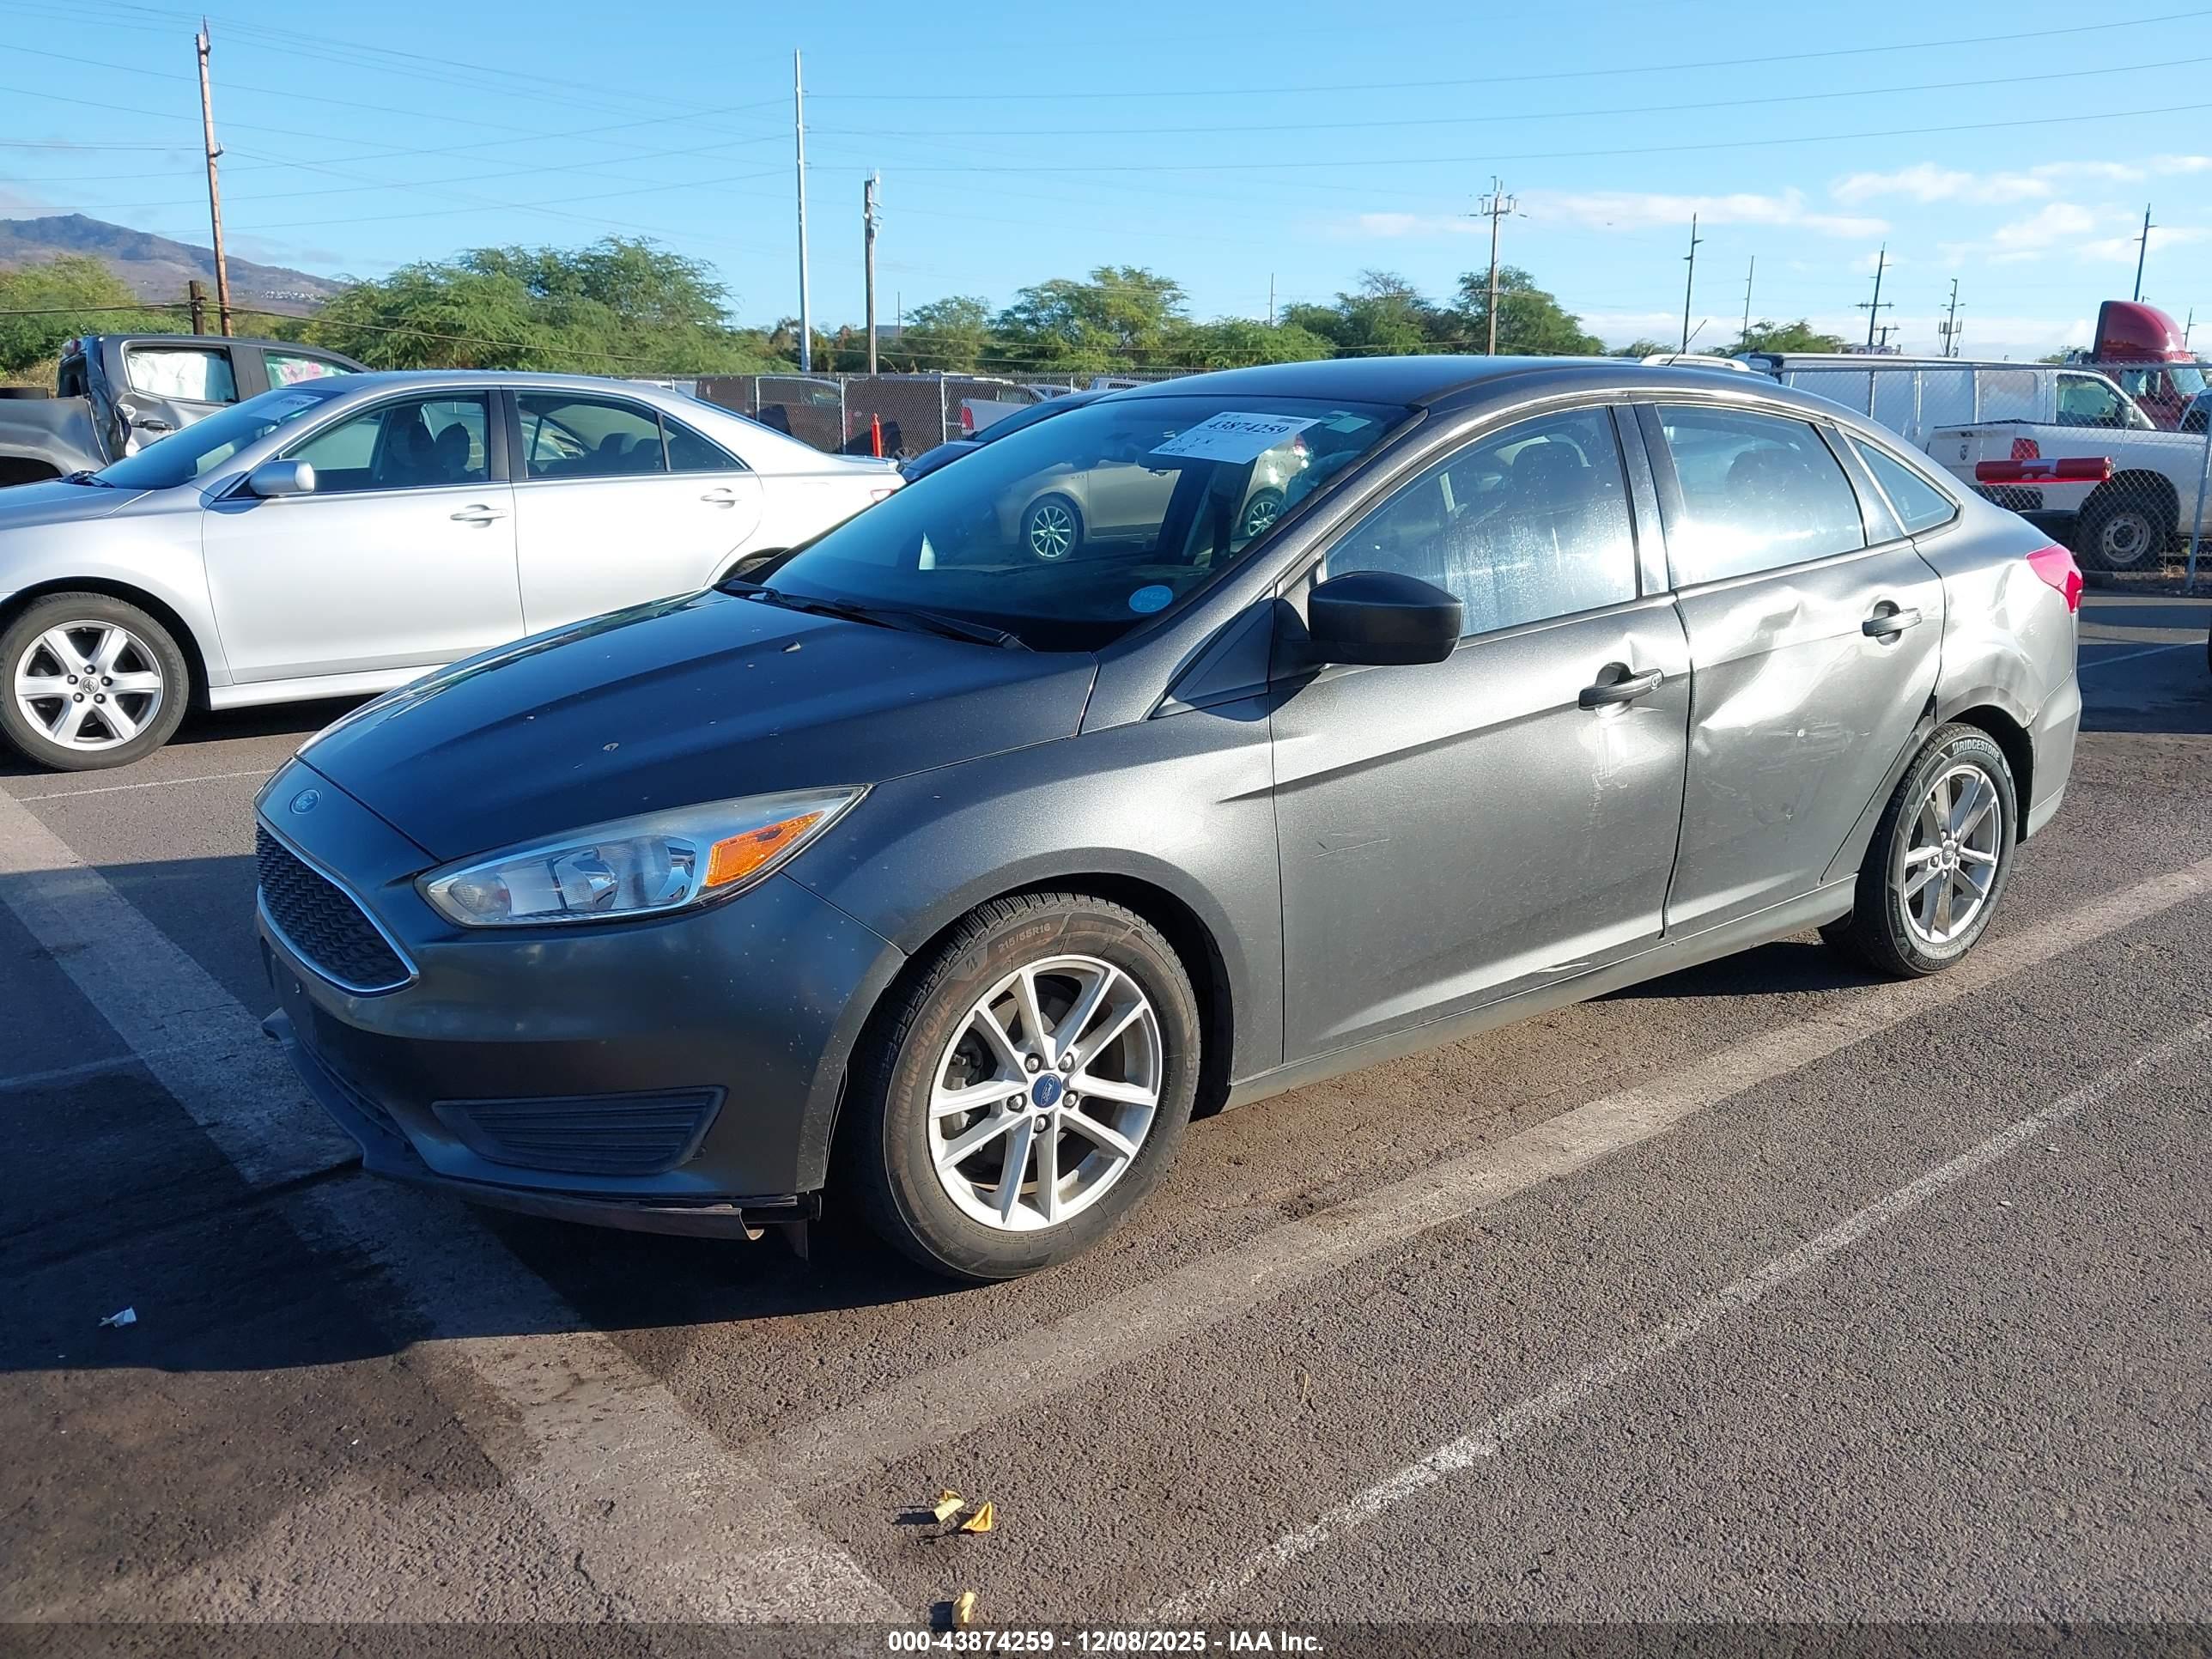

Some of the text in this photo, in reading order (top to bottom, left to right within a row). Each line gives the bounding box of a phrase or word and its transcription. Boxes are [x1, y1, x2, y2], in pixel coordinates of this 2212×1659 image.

[1207, 420, 1290, 434] 43874259
[1951, 738, 2001, 762] BRIDGESTONE
[997, 922, 1052, 954] 215/55R16
